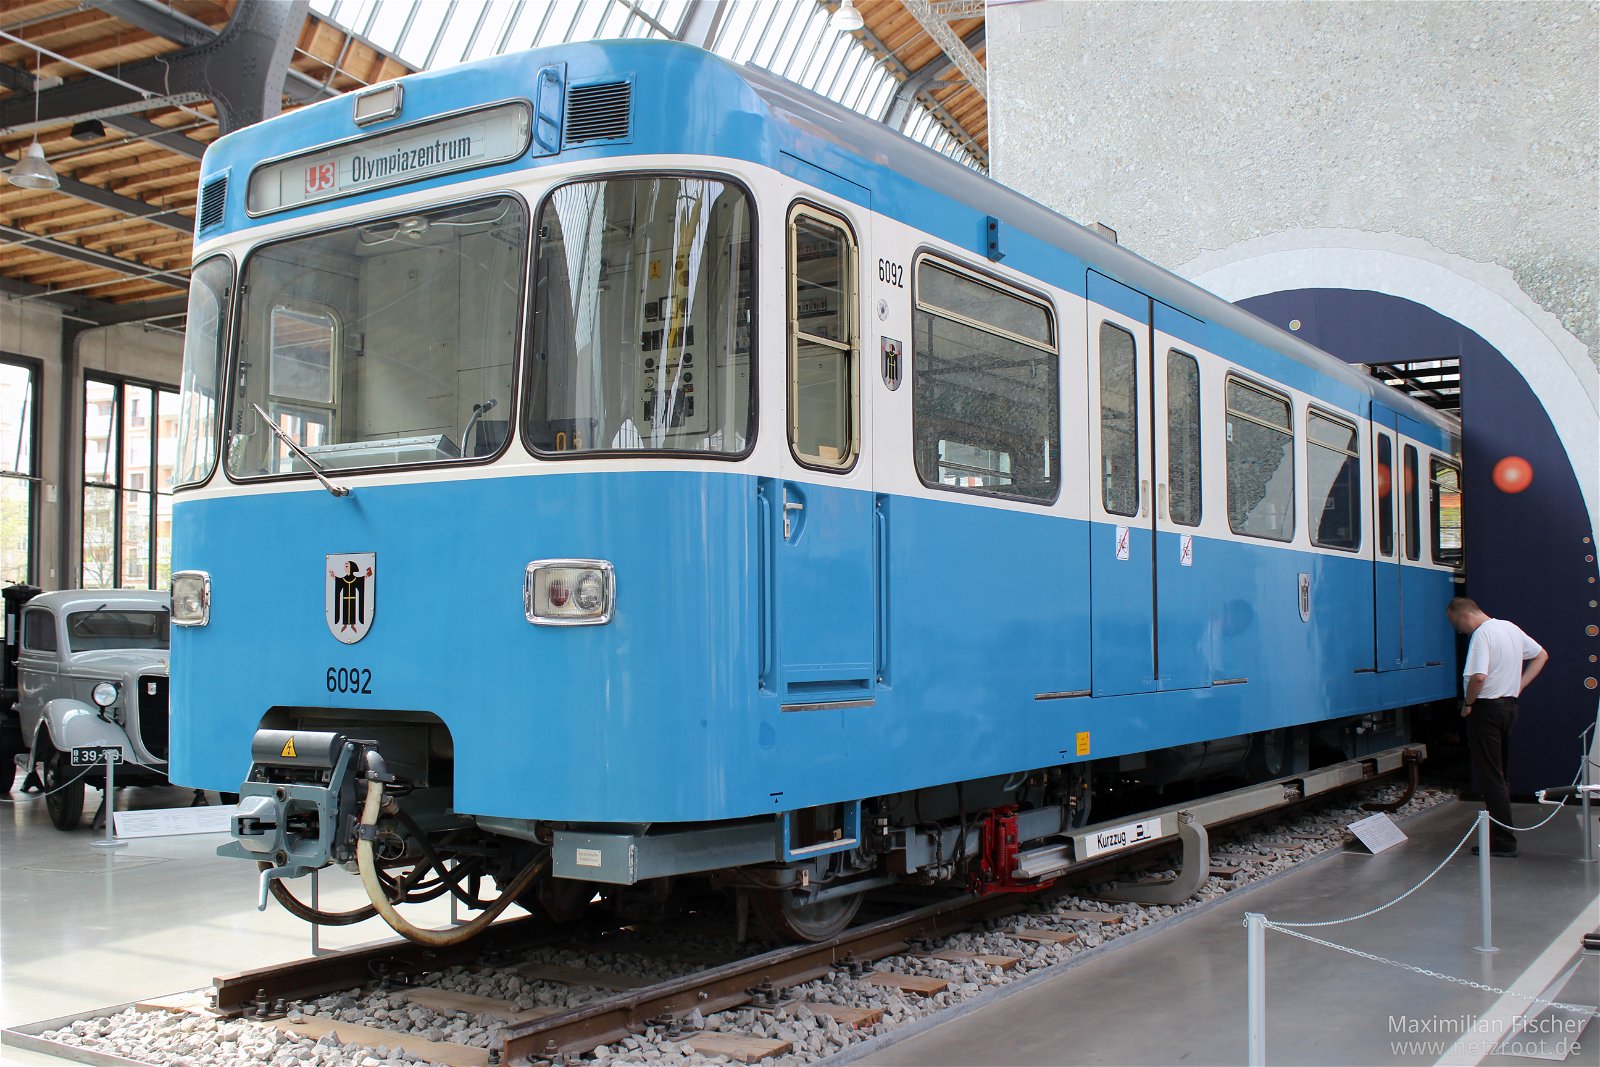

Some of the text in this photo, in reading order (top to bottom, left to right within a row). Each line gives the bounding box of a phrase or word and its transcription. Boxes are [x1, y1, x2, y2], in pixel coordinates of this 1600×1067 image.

[305, 136, 471, 193] U3 Olympiazentrum
[879, 258, 903, 288] 6092
[326, 667, 372, 694] 6092
[1097, 833, 1127, 850] Kurzzug
